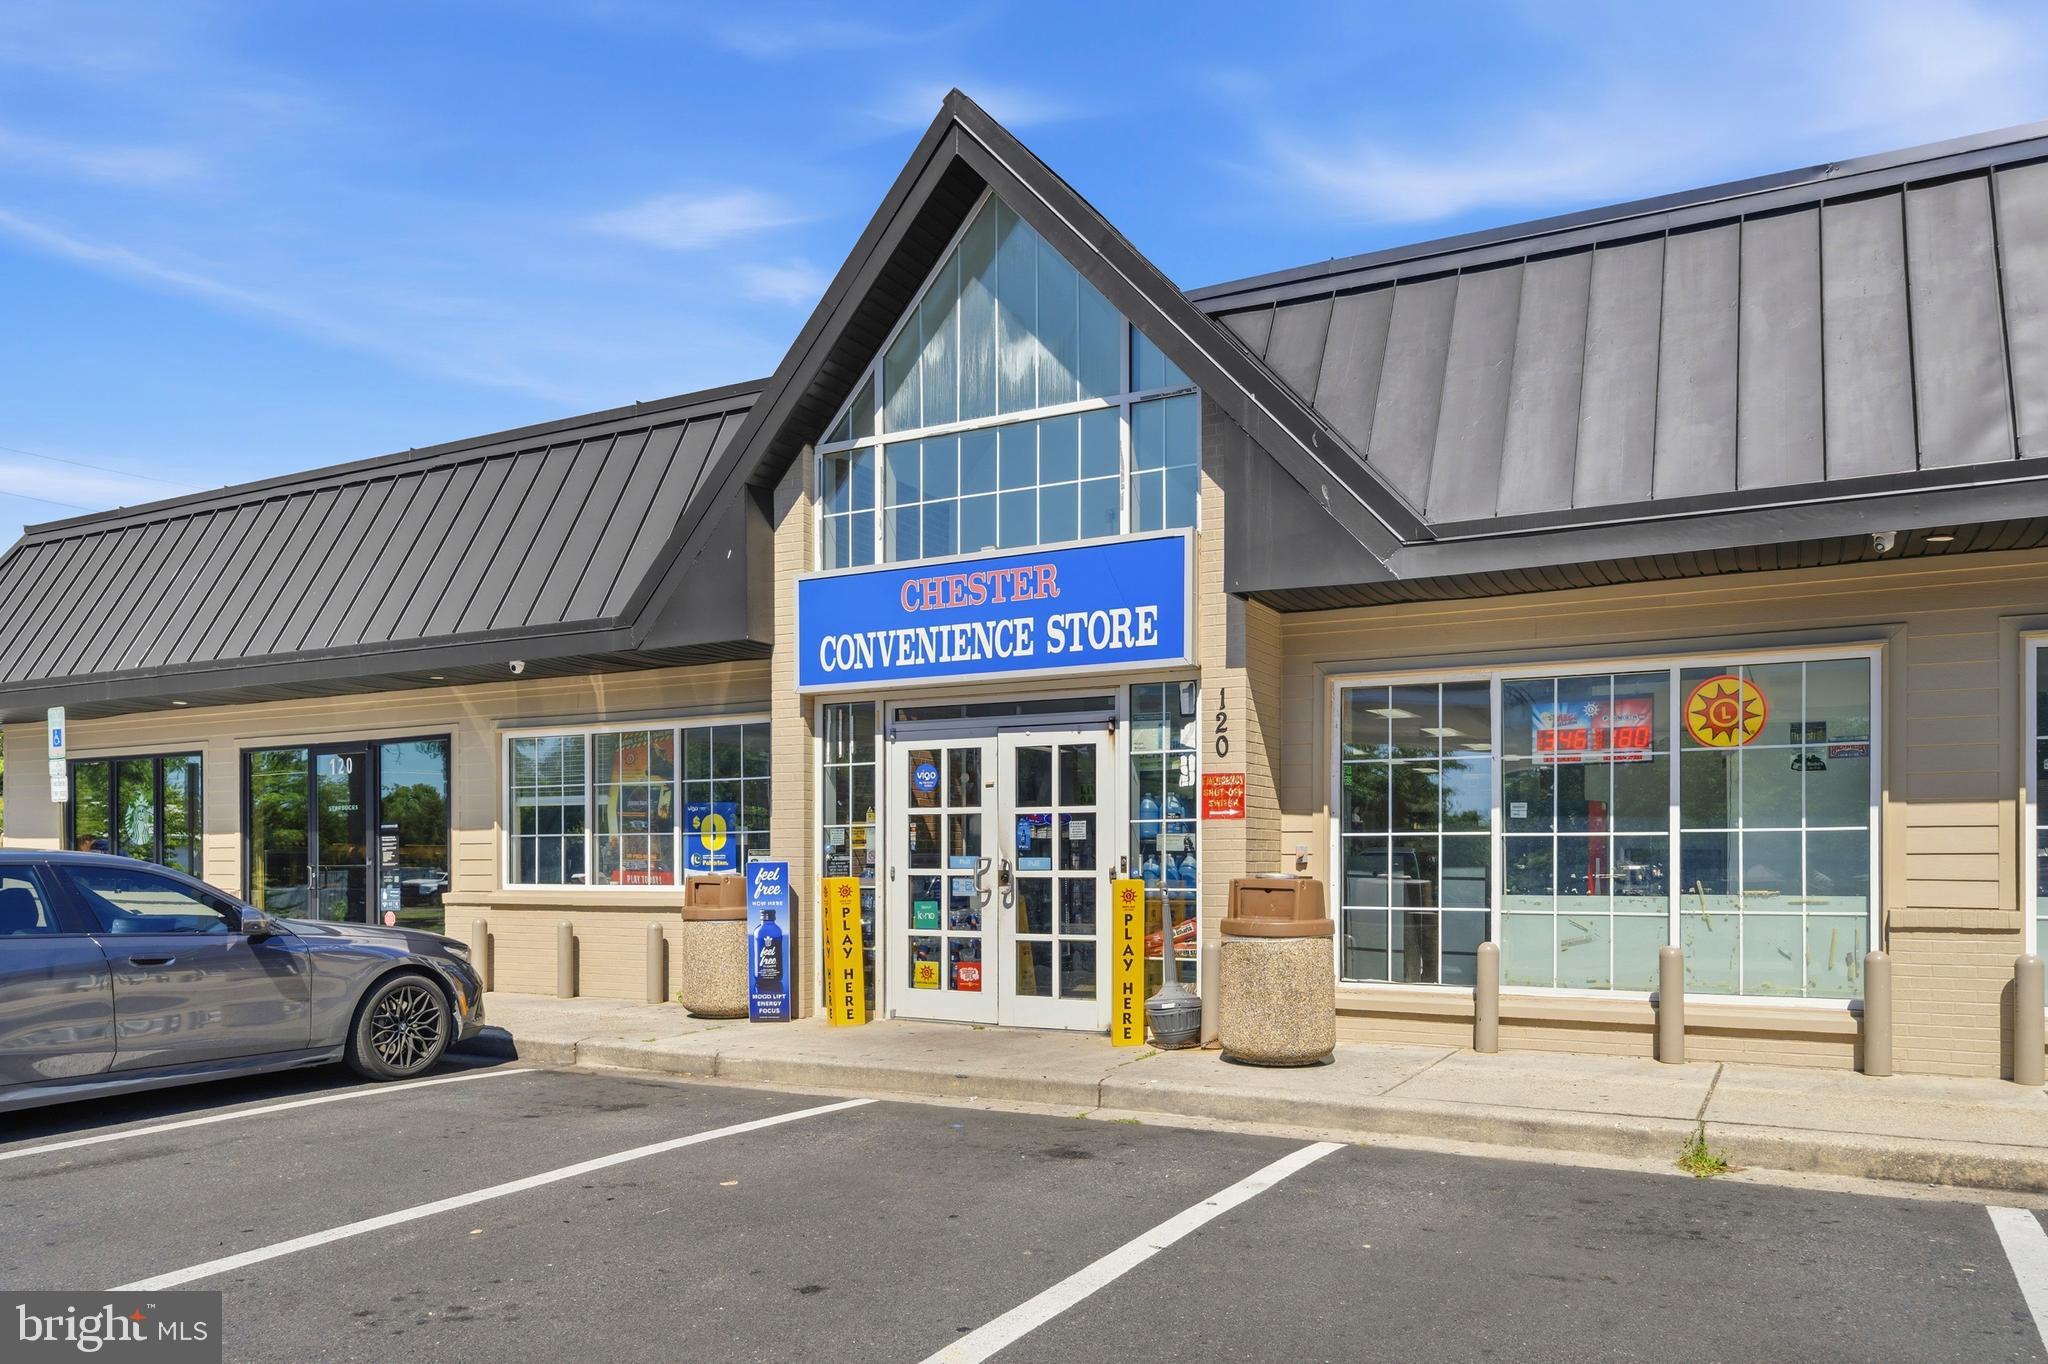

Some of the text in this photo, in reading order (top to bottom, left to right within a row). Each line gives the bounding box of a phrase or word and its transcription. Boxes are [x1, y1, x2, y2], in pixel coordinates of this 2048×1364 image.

[901, 563, 1060, 613] CHESTER
[819, 605, 1158, 673] CONVENIENCE STORE
[1215, 688, 1229, 758] 120
[1721, 706, 1731, 720] L
[329, 757, 353, 775] 120
[916, 770, 936, 781] vigo
[754, 867, 780, 884] feel
[842, 908, 853, 959] PLAY
[1122, 914, 1134, 971] PLAY
[844, 968, 854, 1020] HERE
[1122, 982, 1134, 1039] HERE
